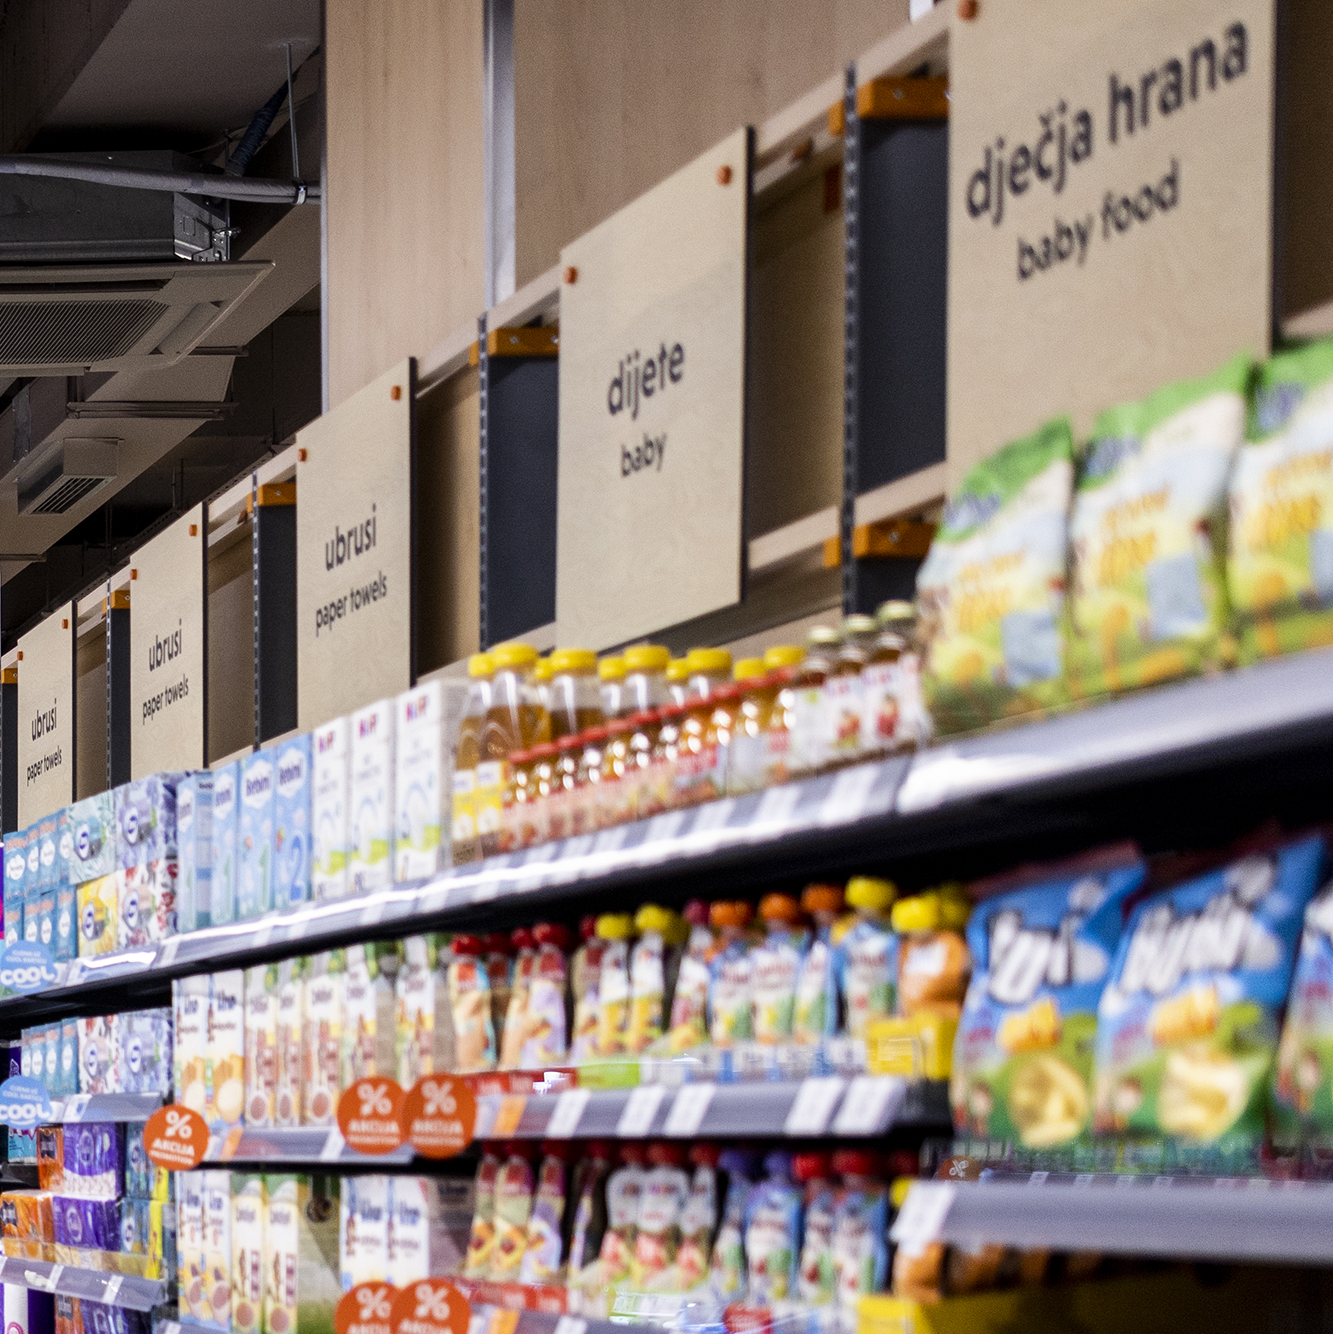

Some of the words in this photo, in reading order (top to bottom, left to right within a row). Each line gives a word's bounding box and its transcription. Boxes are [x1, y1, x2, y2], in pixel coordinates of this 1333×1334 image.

[966, 99, 1094, 227] dječja
[1108, 20, 1250, 146] hrana
[1016, 208, 1093, 283] baby
[1099, 156, 1181, 243] food
[607, 339, 685, 423] dijete
[619, 431, 667, 479] baby
[324, 503, 377, 574] ubrusi
[314, 588, 348, 638] paper
[350, 569, 388, 618] towels
[147, 618, 183, 673] ubrusi
[31, 698, 58, 742] ubrusi
[141, 686, 166, 727] paper
[167, 673, 190, 713] towels
[26, 756, 44, 788] paper
[45, 745, 63, 776] towels
[0, 966, 56, 985] COOL
[152, 1138, 195, 1157] AKCIJA
[348, 1119, 400, 1135] AKCIJA
[409, 1117, 465, 1135] AKCIJA
